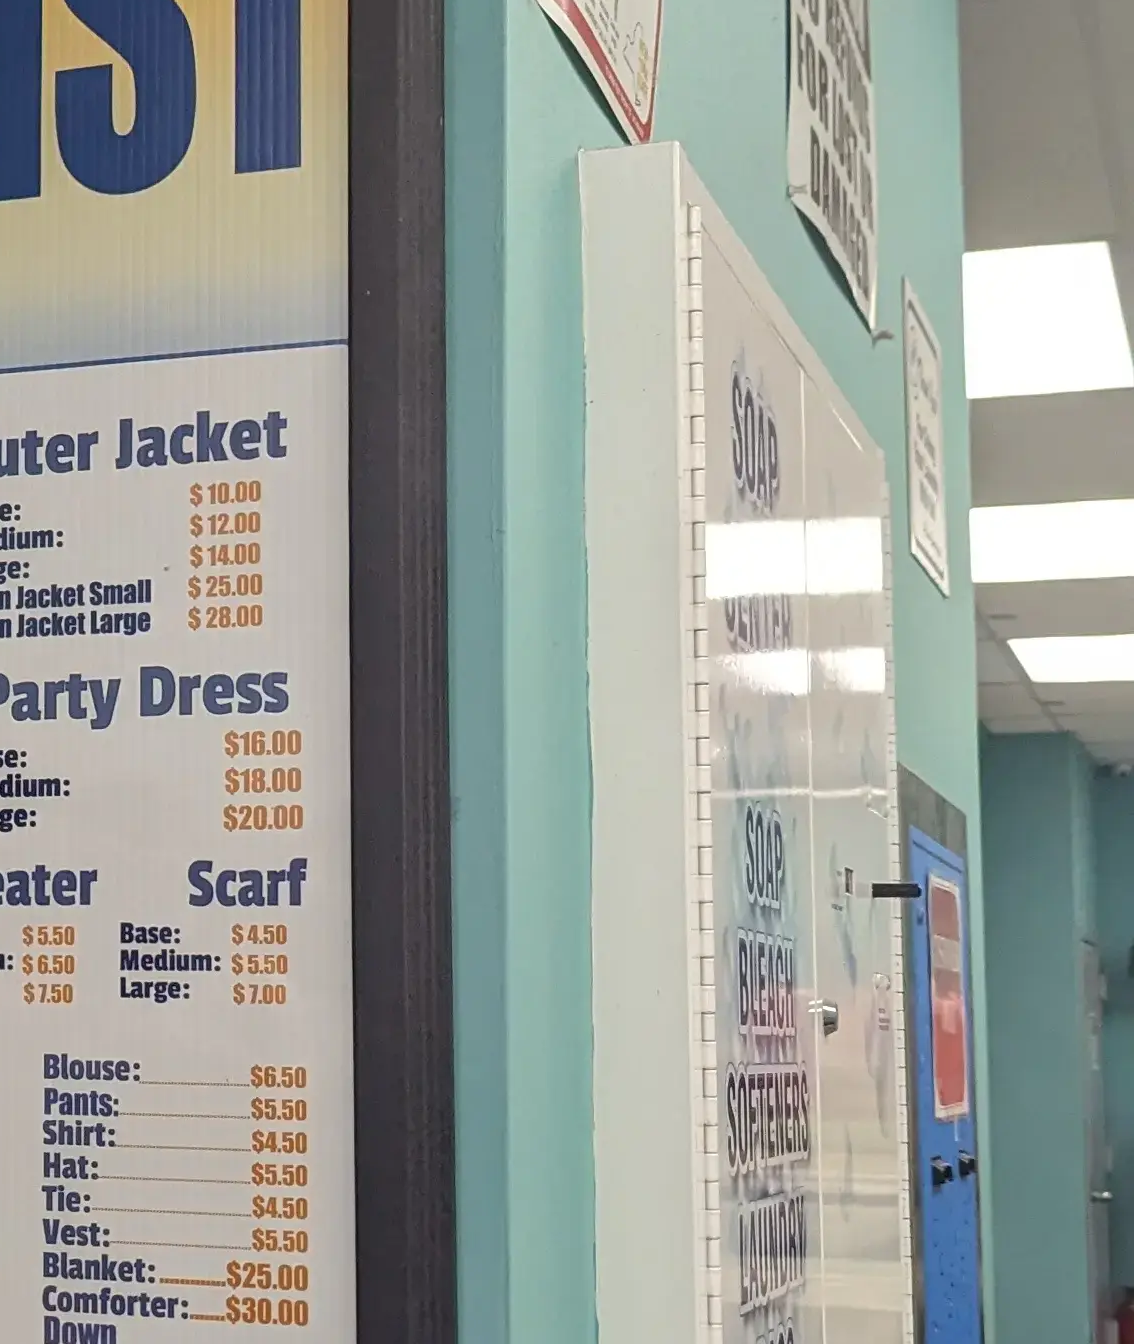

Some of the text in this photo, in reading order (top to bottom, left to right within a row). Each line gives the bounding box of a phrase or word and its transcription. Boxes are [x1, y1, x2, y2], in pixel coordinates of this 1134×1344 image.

[115, 410, 288, 470] Jacket
[730, 362, 779, 513] SOAP
[15, 582, 86, 611] Jacket
[89, 579, 152, 607] Small
[16, 612, 86, 640] Jacket
[90, 609, 151, 637] Large
[139, 665, 289, 719] Dress
[224, 730, 302, 759] $16.00
[224, 767, 302, 795] $18.00
[223, 804, 304, 833] $20.00
[745, 799, 785, 913] SOAP
[187, 857, 308, 908] Scarf
[736, 929, 796, 1037] BLEACH
[43, 1054, 308, 1091] Blouse: $6.50
[43, 1088, 308, 1124] Pants: $5.50
[726, 1062, 811, 1179] SOFTENERS
[42, 1119, 308, 1156] Shirt: $4.50
[42, 1152, 308, 1189] Hat: $5.50
[41, 1186, 309, 1222] Tie: $4.50
[42, 1218, 309, 1255] Vest: $5.50
[738, 1186, 807, 1317] LAUNDRY
[42, 1251, 309, 1294] Blanket: $25.00
[41, 1285, 310, 1328] Comforter: $30.00
